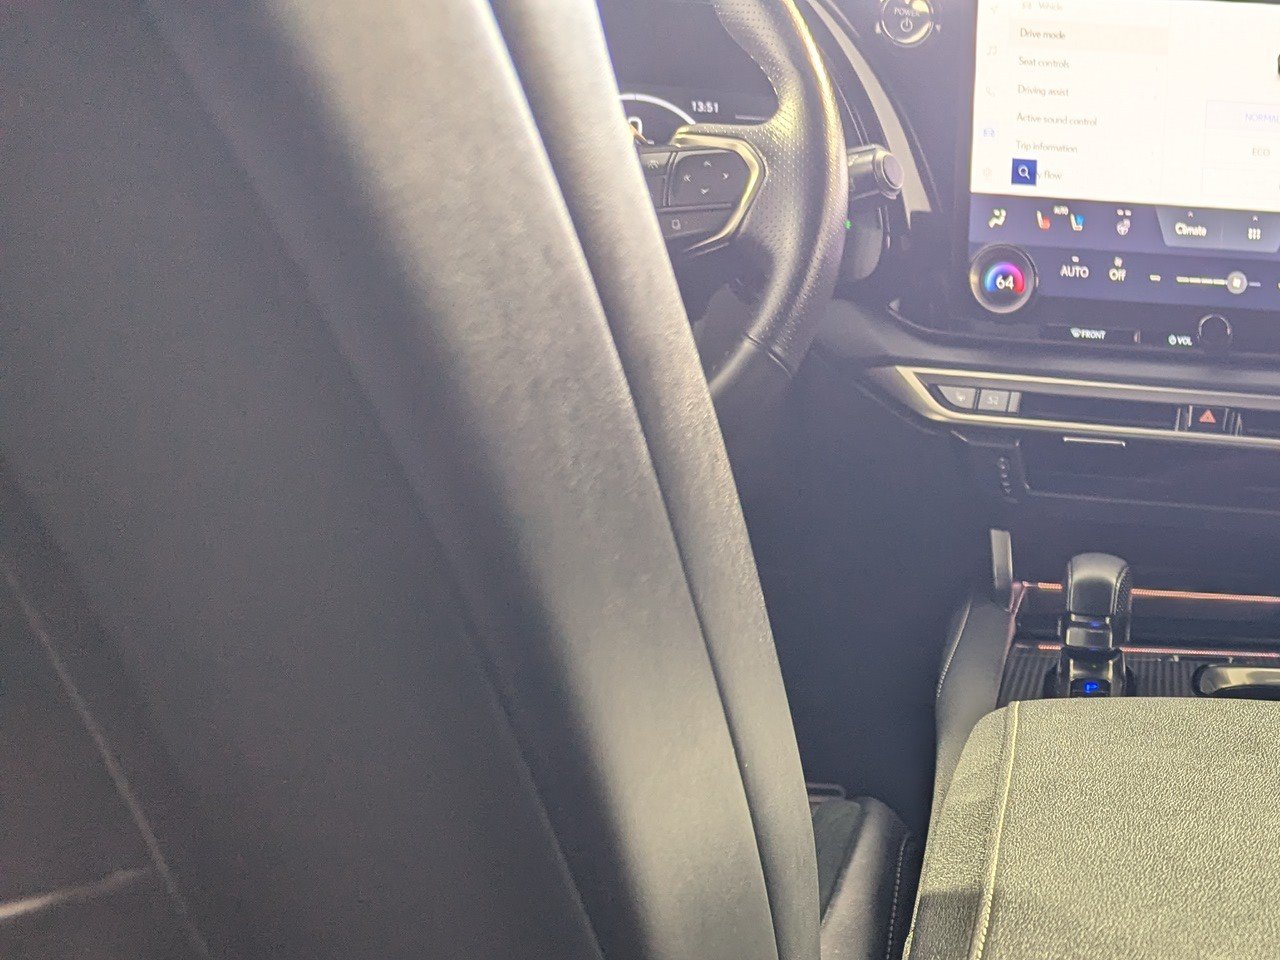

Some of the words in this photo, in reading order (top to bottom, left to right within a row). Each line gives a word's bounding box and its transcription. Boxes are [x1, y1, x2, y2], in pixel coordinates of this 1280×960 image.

[1019, 27, 1041, 39] Drive
[1042, 30, 1066, 40] mode
[1018, 56, 1036, 66] Seat
[1038, 58, 1070, 69] controls
[1017, 84, 1046, 97] Driving
[1048, 87, 1069, 96] assist
[691, 100, 719, 114] 13:51
[1016, 112, 1042, 123] Active
[1043, 115, 1068, 125] sound
[1069, 116, 1097, 126] control
[1244, 112, 1280, 123] NORMAL
[1015, 140, 1031, 152] Trip
[1033, 142, 1078, 153] information
[1252, 147, 1271, 157] ECO
[1044, 169, 1062, 180] flow
[1175, 221, 1207, 237] Climate
[1060, 265, 1089, 279] AUTO
[1109, 268, 1126, 282] Off
[995, 276, 1014, 291] 64
[1081, 329, 1106, 340] FRONT
[1177, 336, 1193, 347] VOL
